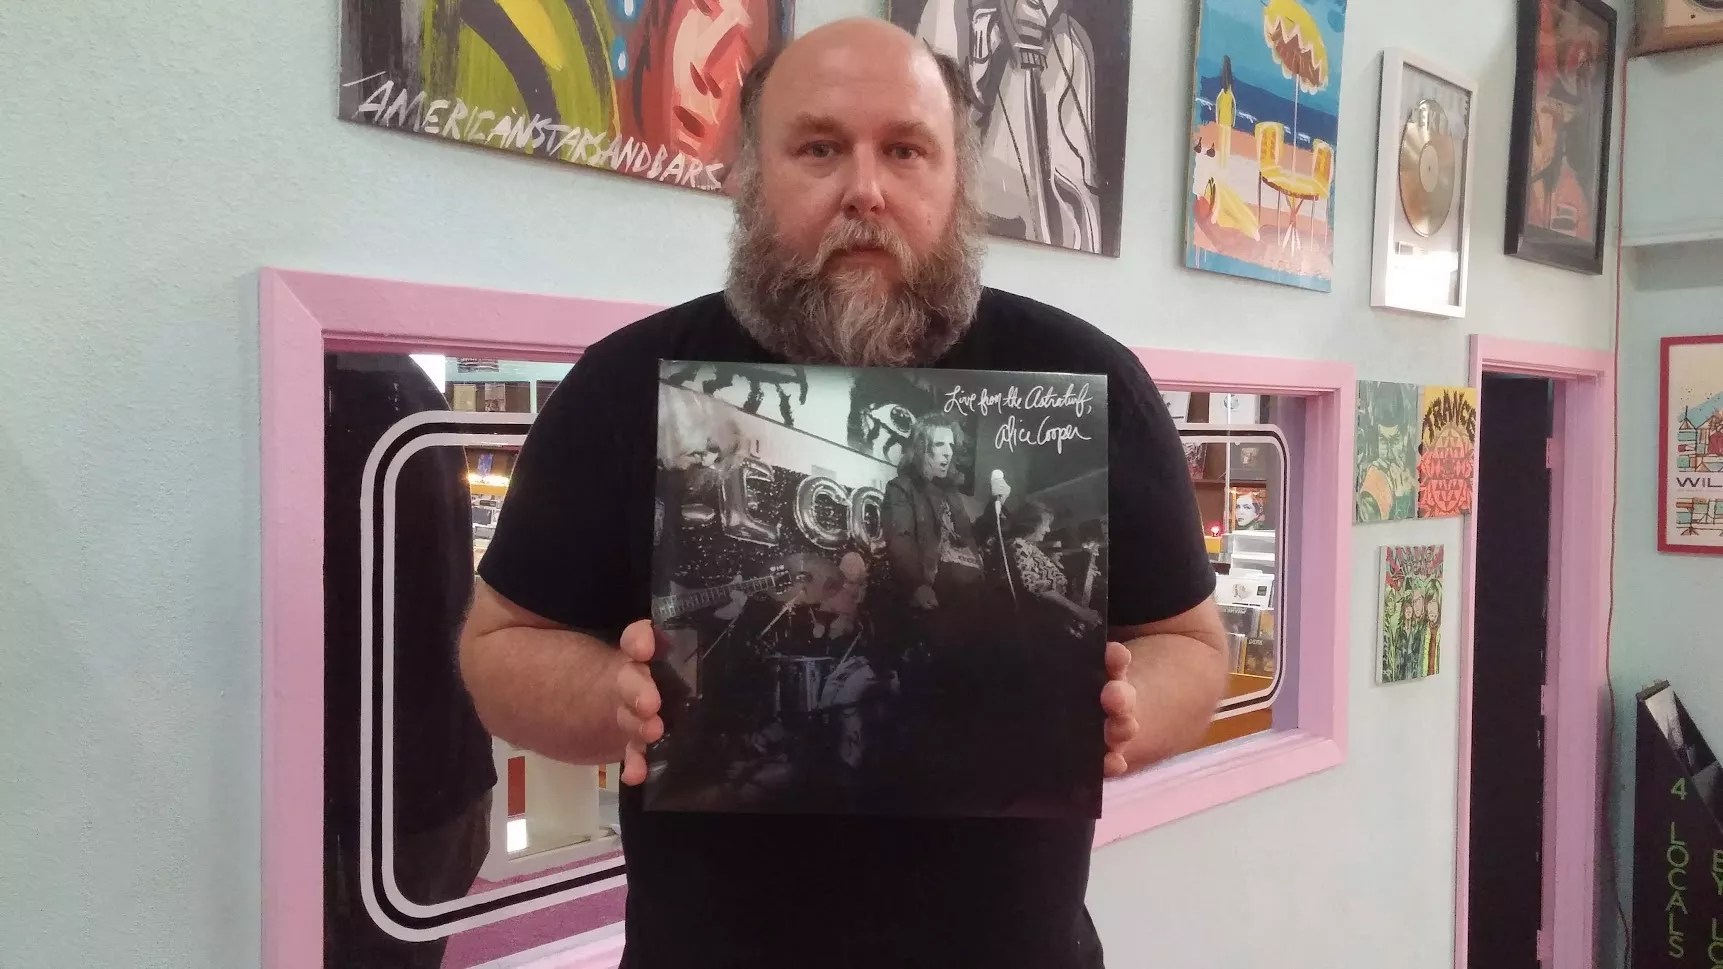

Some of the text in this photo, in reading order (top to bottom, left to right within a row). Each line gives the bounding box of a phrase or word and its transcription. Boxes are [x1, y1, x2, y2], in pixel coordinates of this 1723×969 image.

[943, 385, 977, 416] Live
[977, 388, 1002, 416] from
[1003, 385, 1022, 410] the
[1037, 416, 1092, 454] Cooper
[1665, 777, 1690, 959] 4 LOCALS
